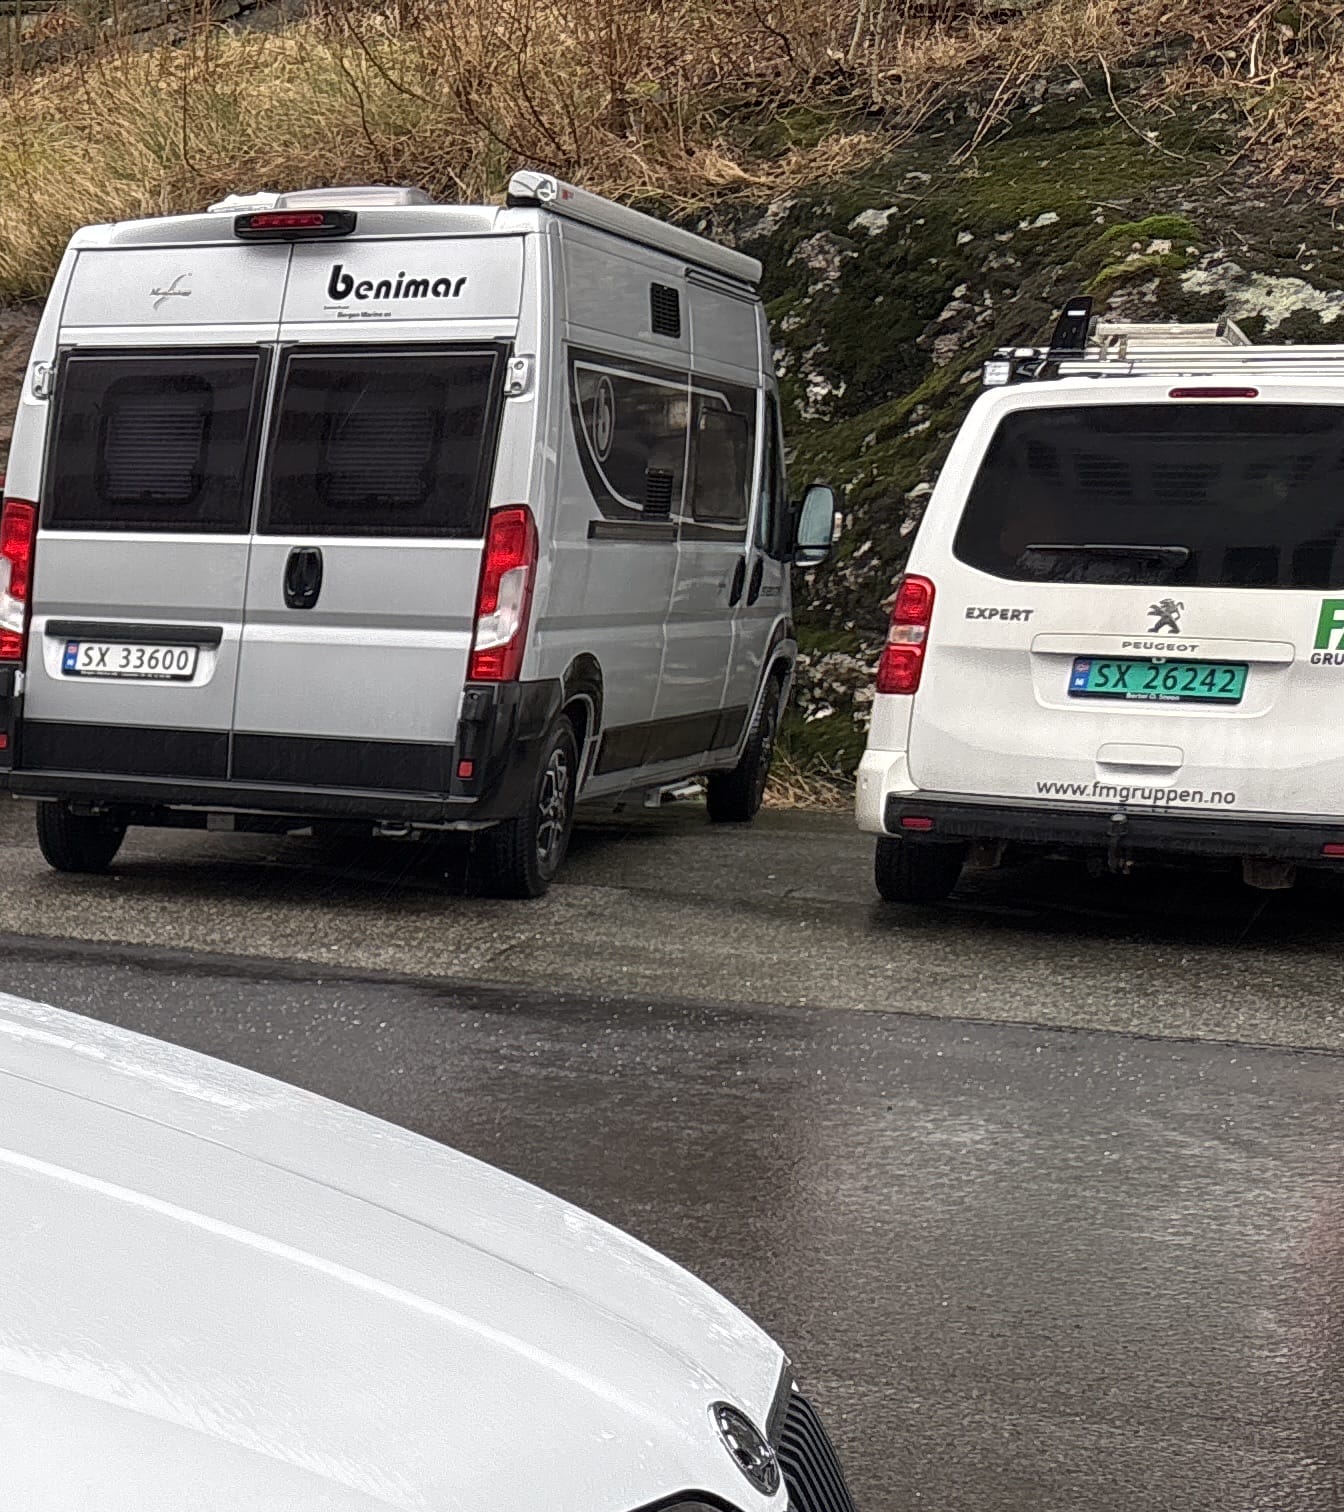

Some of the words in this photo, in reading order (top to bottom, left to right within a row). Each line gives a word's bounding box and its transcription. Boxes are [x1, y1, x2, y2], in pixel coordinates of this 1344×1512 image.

[327, 264, 467, 301] benimar
[965, 607, 1034, 622] EXPERT
[1314, 599, 1344, 650] F
[82, 646, 110, 667] SX
[118, 647, 189, 671] 33600
[1121, 641, 1199, 652] PEUGEOT
[1095, 664, 1132, 689] SX
[1142, 666, 1236, 694] 26242
[1036, 780, 1236, 804] www.fmgruppen.no
